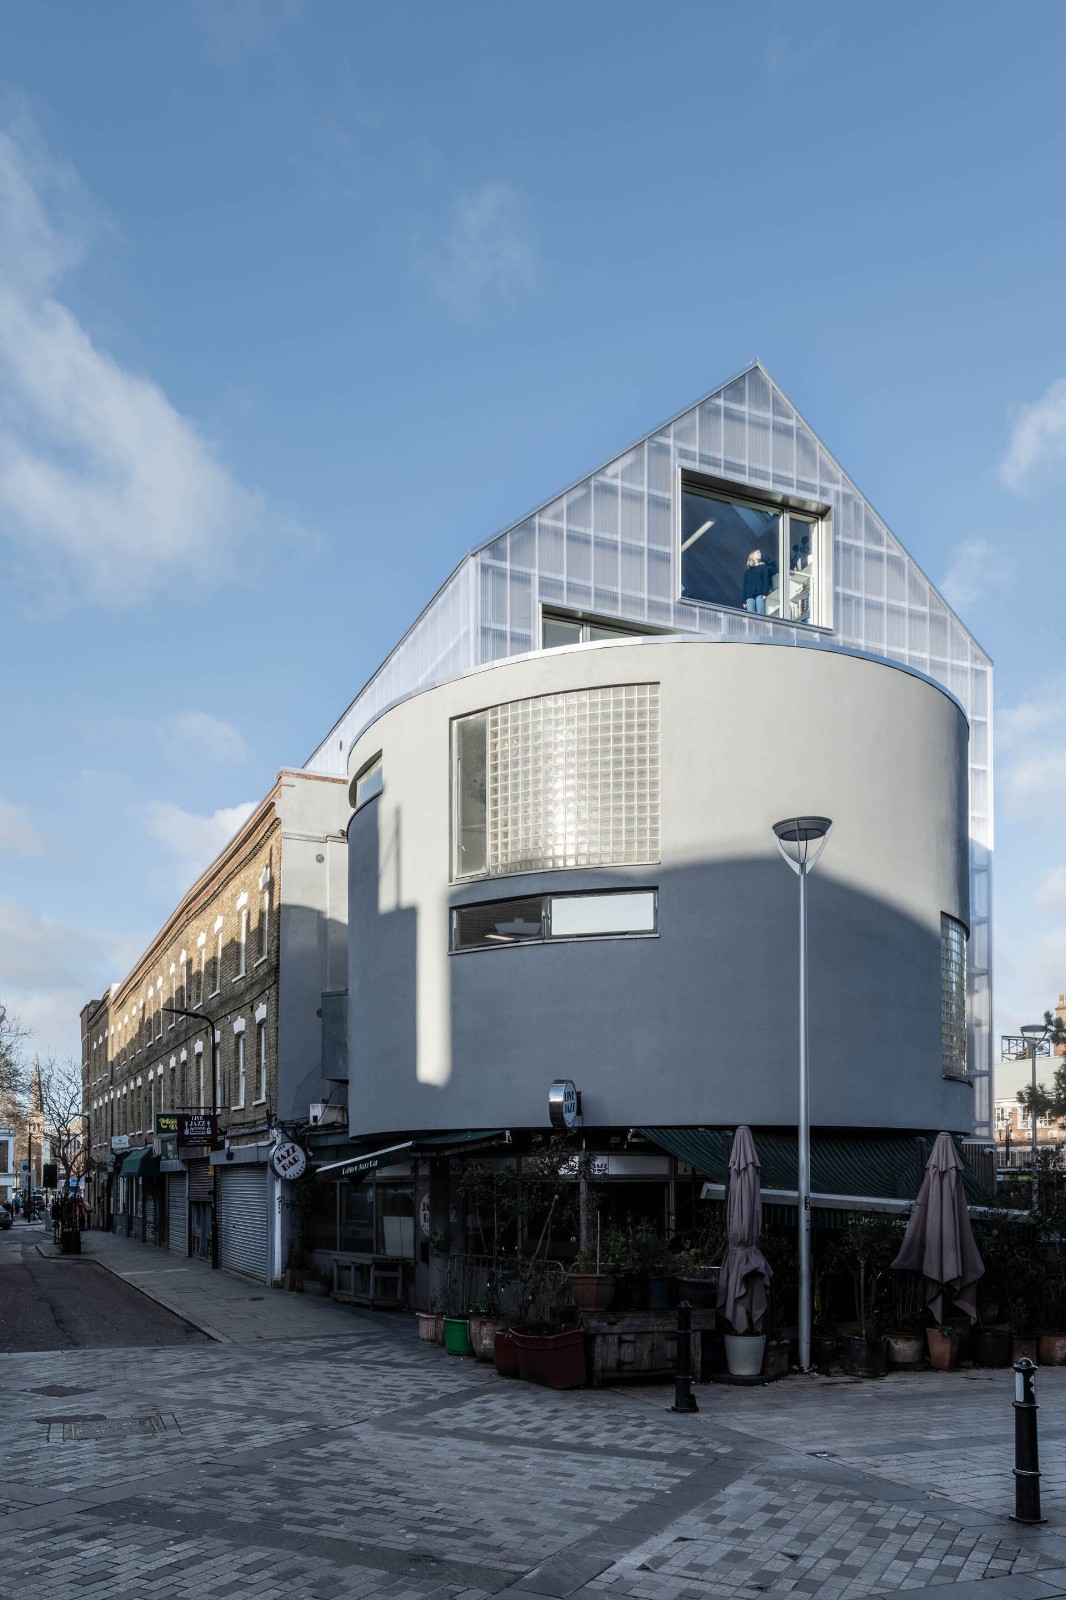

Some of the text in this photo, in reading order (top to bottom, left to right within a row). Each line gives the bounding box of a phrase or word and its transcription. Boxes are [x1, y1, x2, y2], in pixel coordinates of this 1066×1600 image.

[565, 1090, 575, 1102] LIVE
[565, 1103, 575, 1115] JAZZ
[276, 1145, 298, 1165] JAZZ
[281, 1155, 300, 1172] BAR
